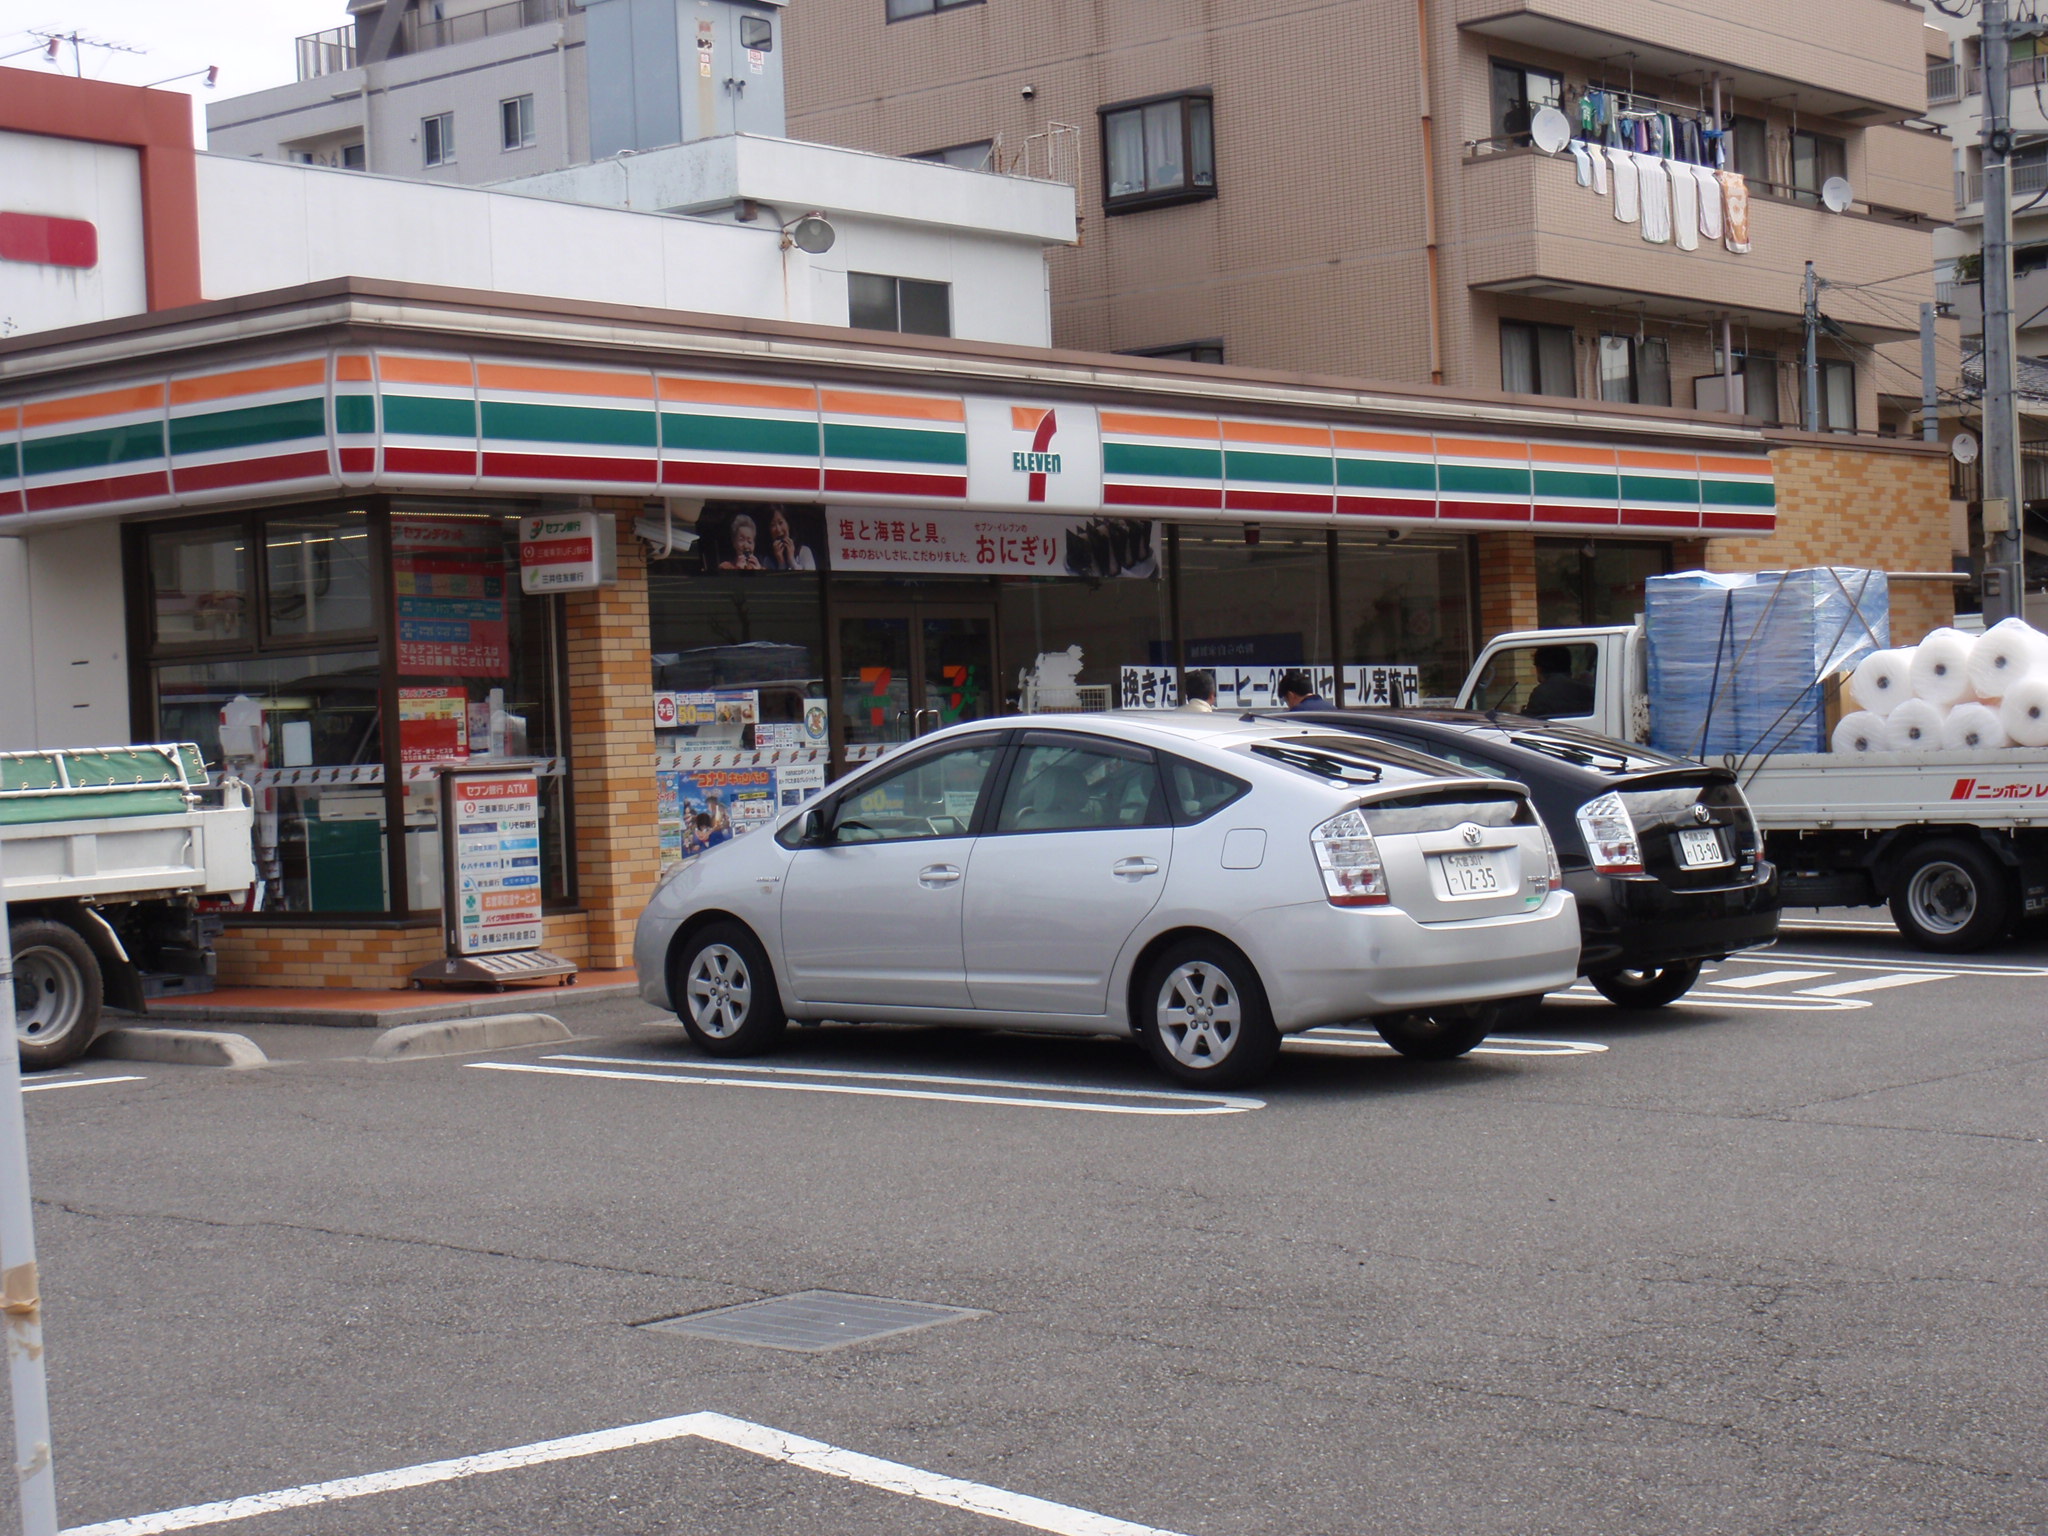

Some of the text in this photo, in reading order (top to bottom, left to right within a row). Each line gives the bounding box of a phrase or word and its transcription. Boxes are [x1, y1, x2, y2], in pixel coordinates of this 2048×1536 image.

[545, 520, 581, 533] セブン銀行
[839, 519, 947, 545] 塩と海苔と具。
[841, 547, 971, 563] 基本のおいしさに、こだわりました。
[975, 534, 1057, 566] おにぎり
[541, 572, 584, 584] 三井住友銀行
[658, 703, 674, 717] 予告
[678, 704, 697, 724] 50
[466, 784, 528, 797] セブン銀行 ATM
[508, 820, 537, 830] りそな銀行
[466, 861, 499, 870] 八千代銀行
[477, 879, 500, 888] 新生銀行
[481, 930, 537, 944] 各種公共料金窓口
